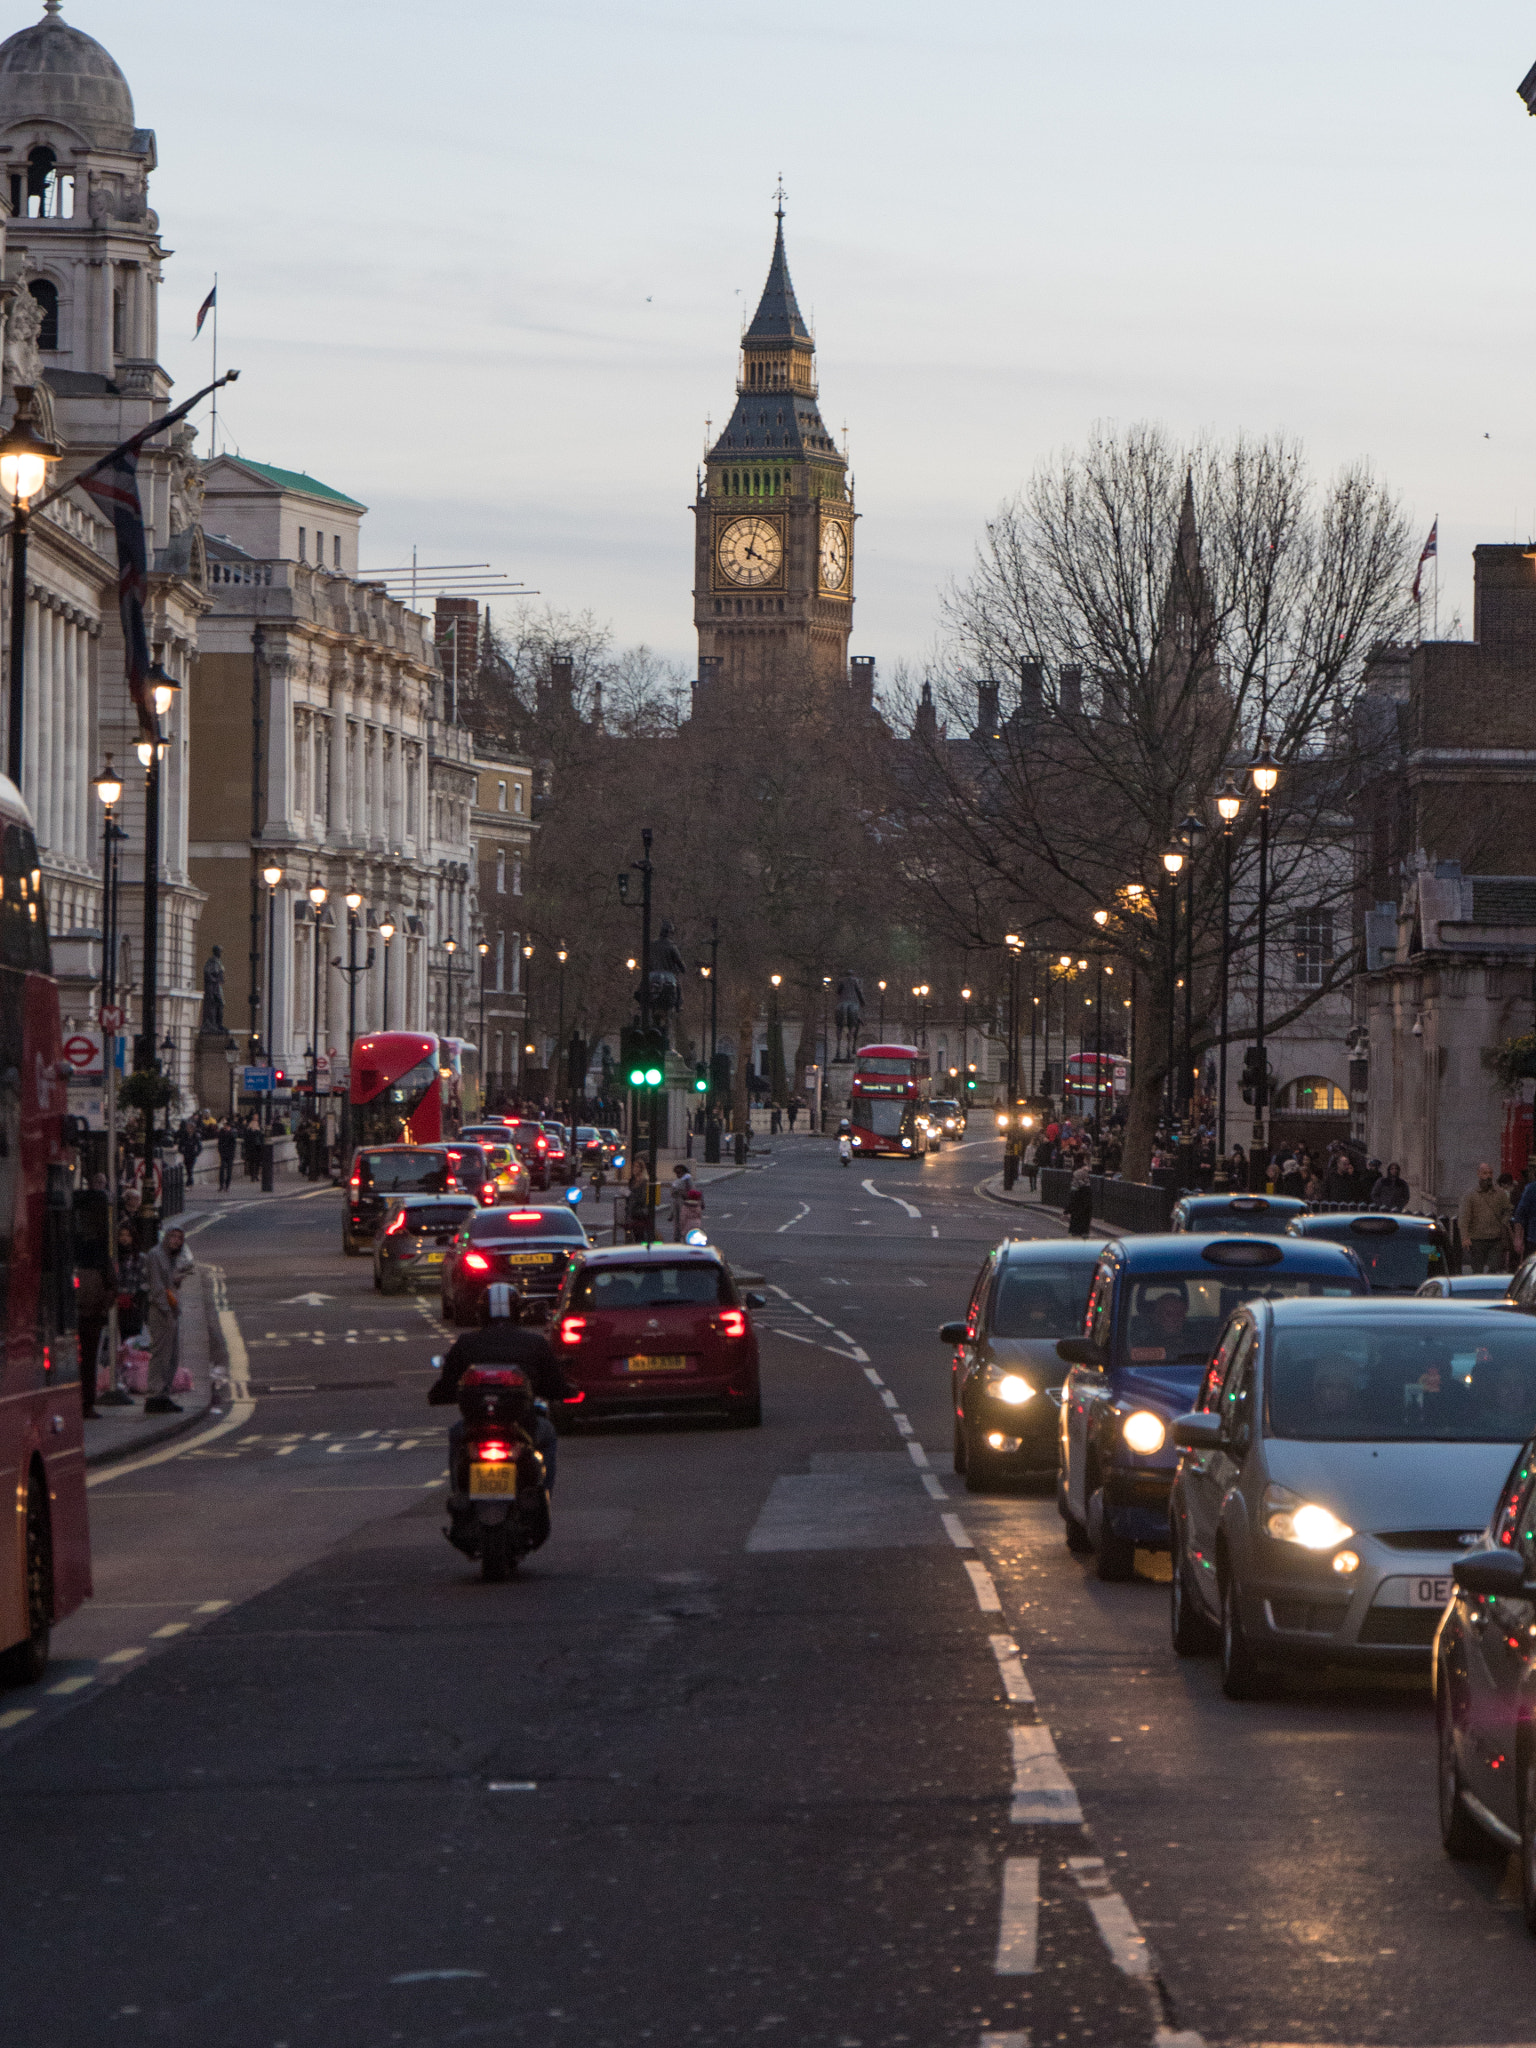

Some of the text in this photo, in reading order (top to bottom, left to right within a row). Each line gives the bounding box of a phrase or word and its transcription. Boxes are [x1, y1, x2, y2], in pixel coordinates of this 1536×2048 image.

[103, 1009, 120, 1026] M
[394, 1089, 404, 1102] 3
[1418, 1580, 1449, 1601] OE
